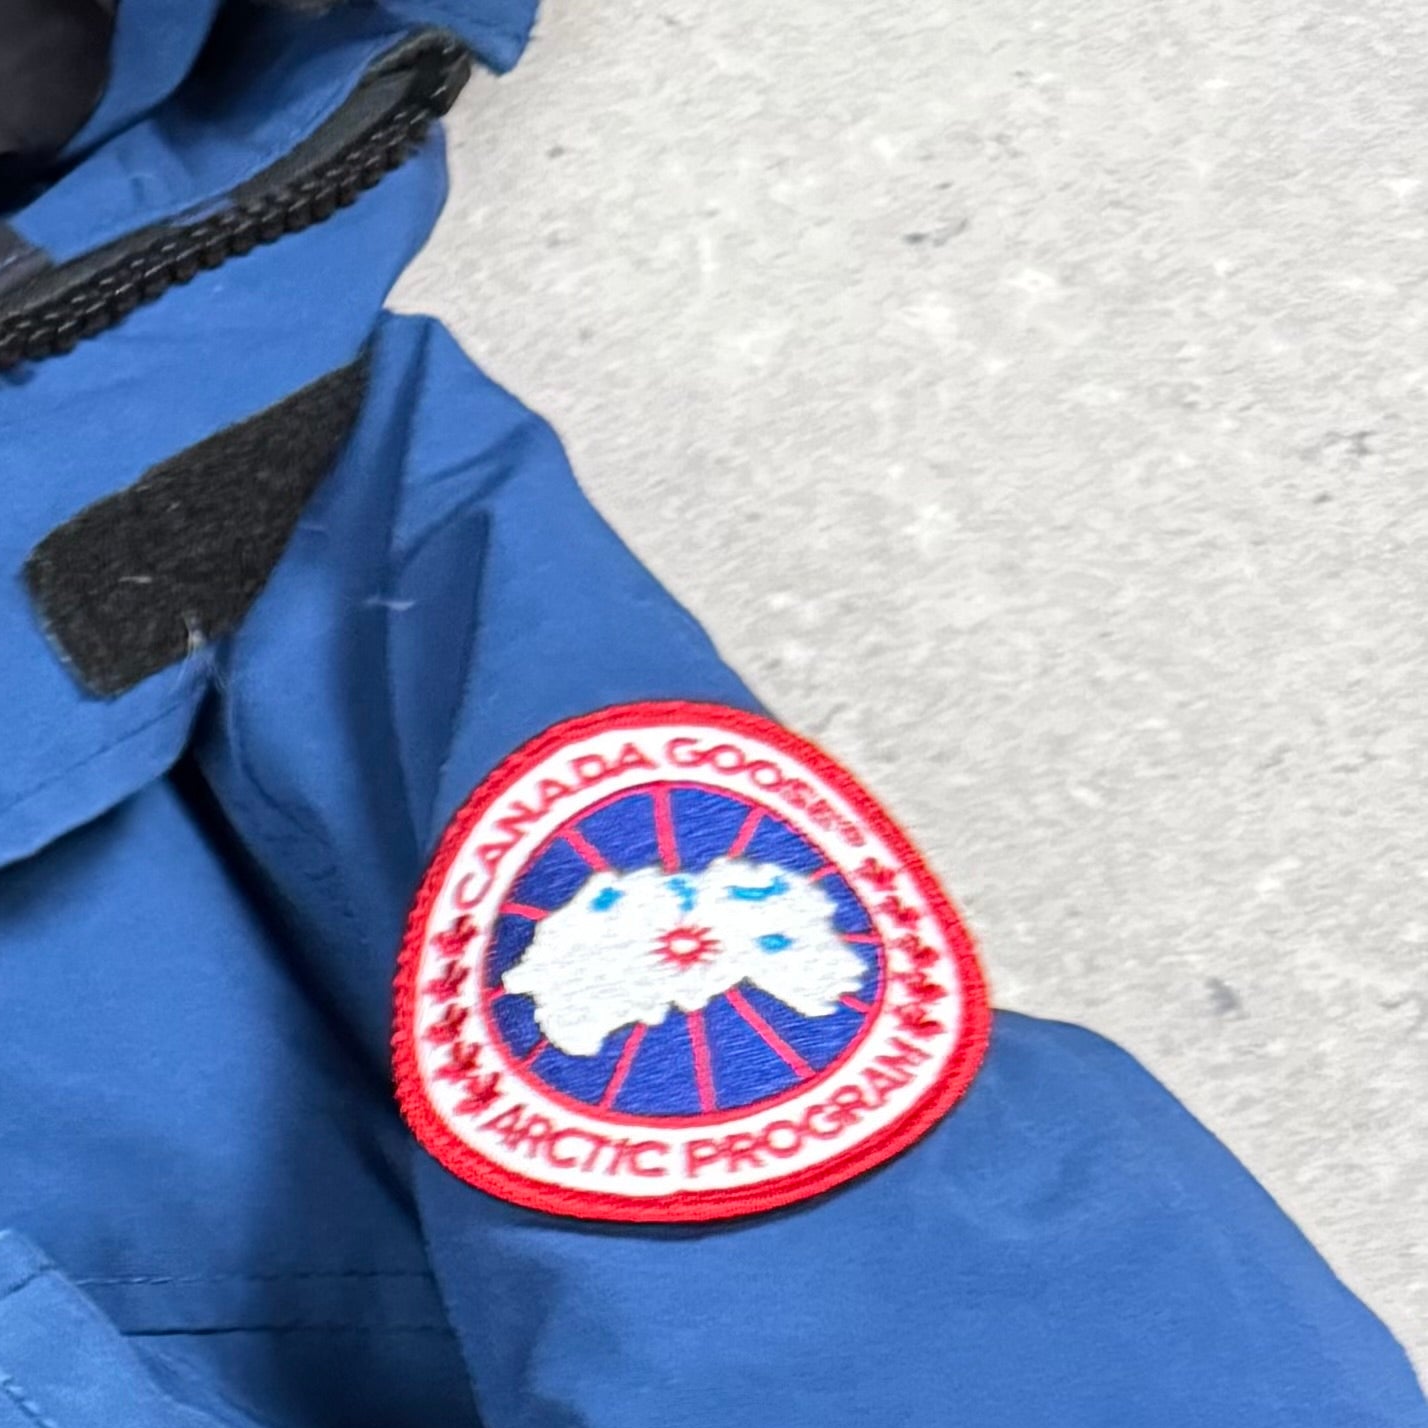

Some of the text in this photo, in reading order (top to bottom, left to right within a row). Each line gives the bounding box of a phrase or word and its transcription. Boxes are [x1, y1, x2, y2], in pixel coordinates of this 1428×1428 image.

[451, 736, 842, 911] CANADA GOOSE
[480, 1036, 931, 1179] ARCTIC PROGRAM
